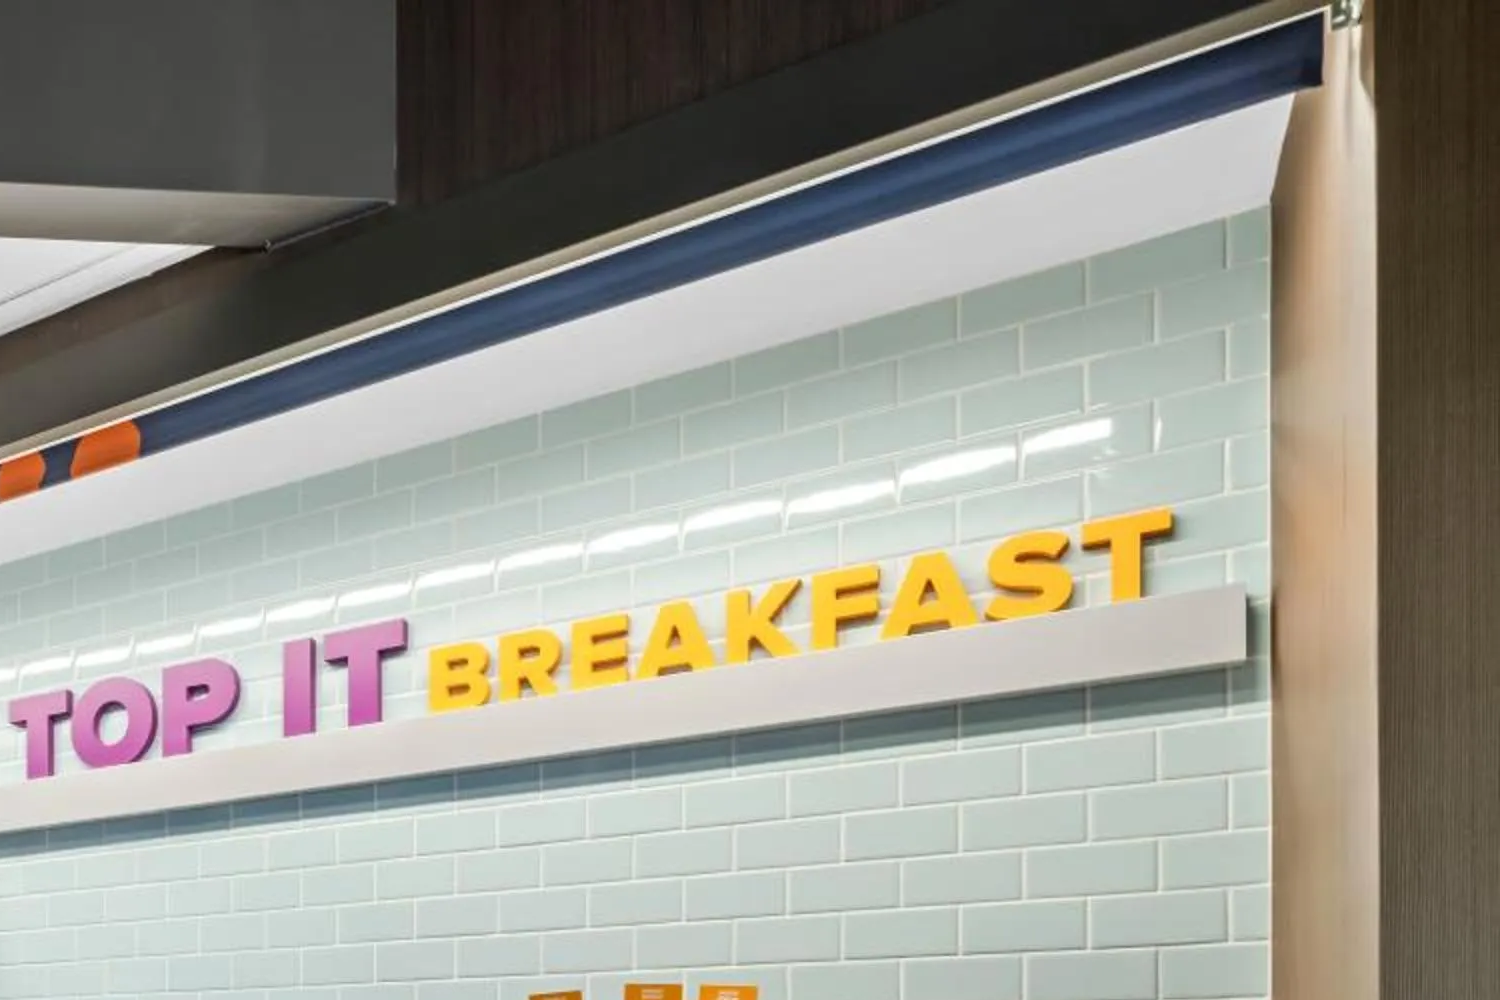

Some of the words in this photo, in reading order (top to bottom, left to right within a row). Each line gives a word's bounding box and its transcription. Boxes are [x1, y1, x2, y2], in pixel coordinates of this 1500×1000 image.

[9, 656, 241, 780] TOP
[283, 617, 409, 737] IT
[428, 506, 1175, 713] BREAKFAST
